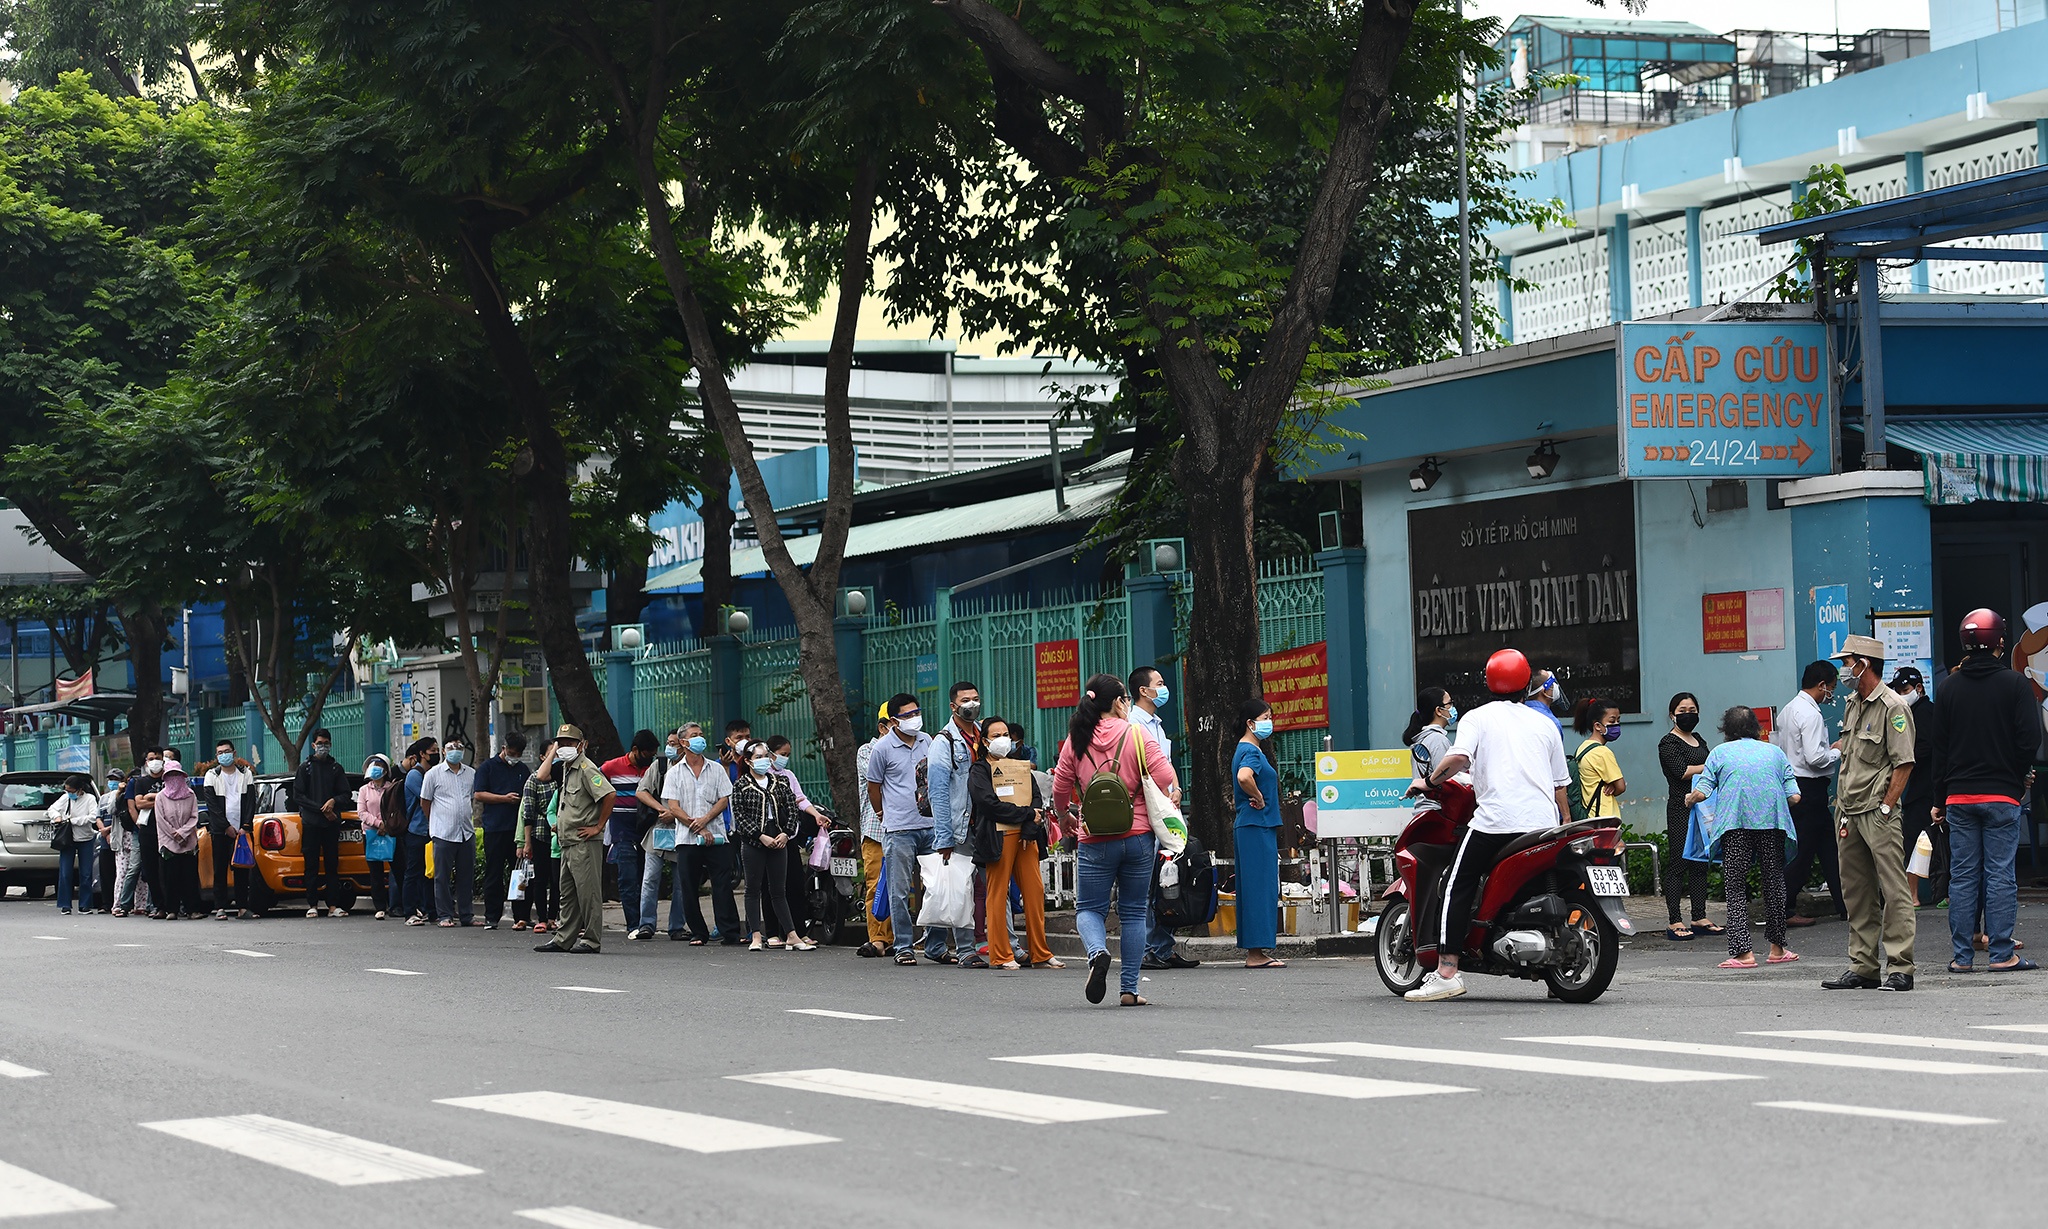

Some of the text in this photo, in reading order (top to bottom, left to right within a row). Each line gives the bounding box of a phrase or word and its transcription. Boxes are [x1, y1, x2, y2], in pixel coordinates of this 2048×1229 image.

[1633, 331, 1818, 383] CẤP CỨU
[1630, 393, 1823, 428] EMERGENCY
[1690, 439, 1760, 466] 24/24
[648, 525, 681, 567] HOA
[681, 521, 705, 560] KH
[1460, 521, 1473, 548] SỞ
[1514, 515, 1528, 540] HỒ
[1530, 515, 1549, 539] CHÍ
[1551, 517, 1578, 537] MINH
[1418, 553, 1631, 647] BỆNH VIỆN BÌNH DÂN
[1818, 595, 1846, 624] CỔNG
[1040, 644, 1073, 664] CỔNG SỐ 1A
[1829, 630, 1838, 658] 1
[1361, 755, 1401, 766] CẤP CỨU
[1365, 787, 1400, 798] LỐI VÀO
[1593, 882, 1626, 894] 987.38
